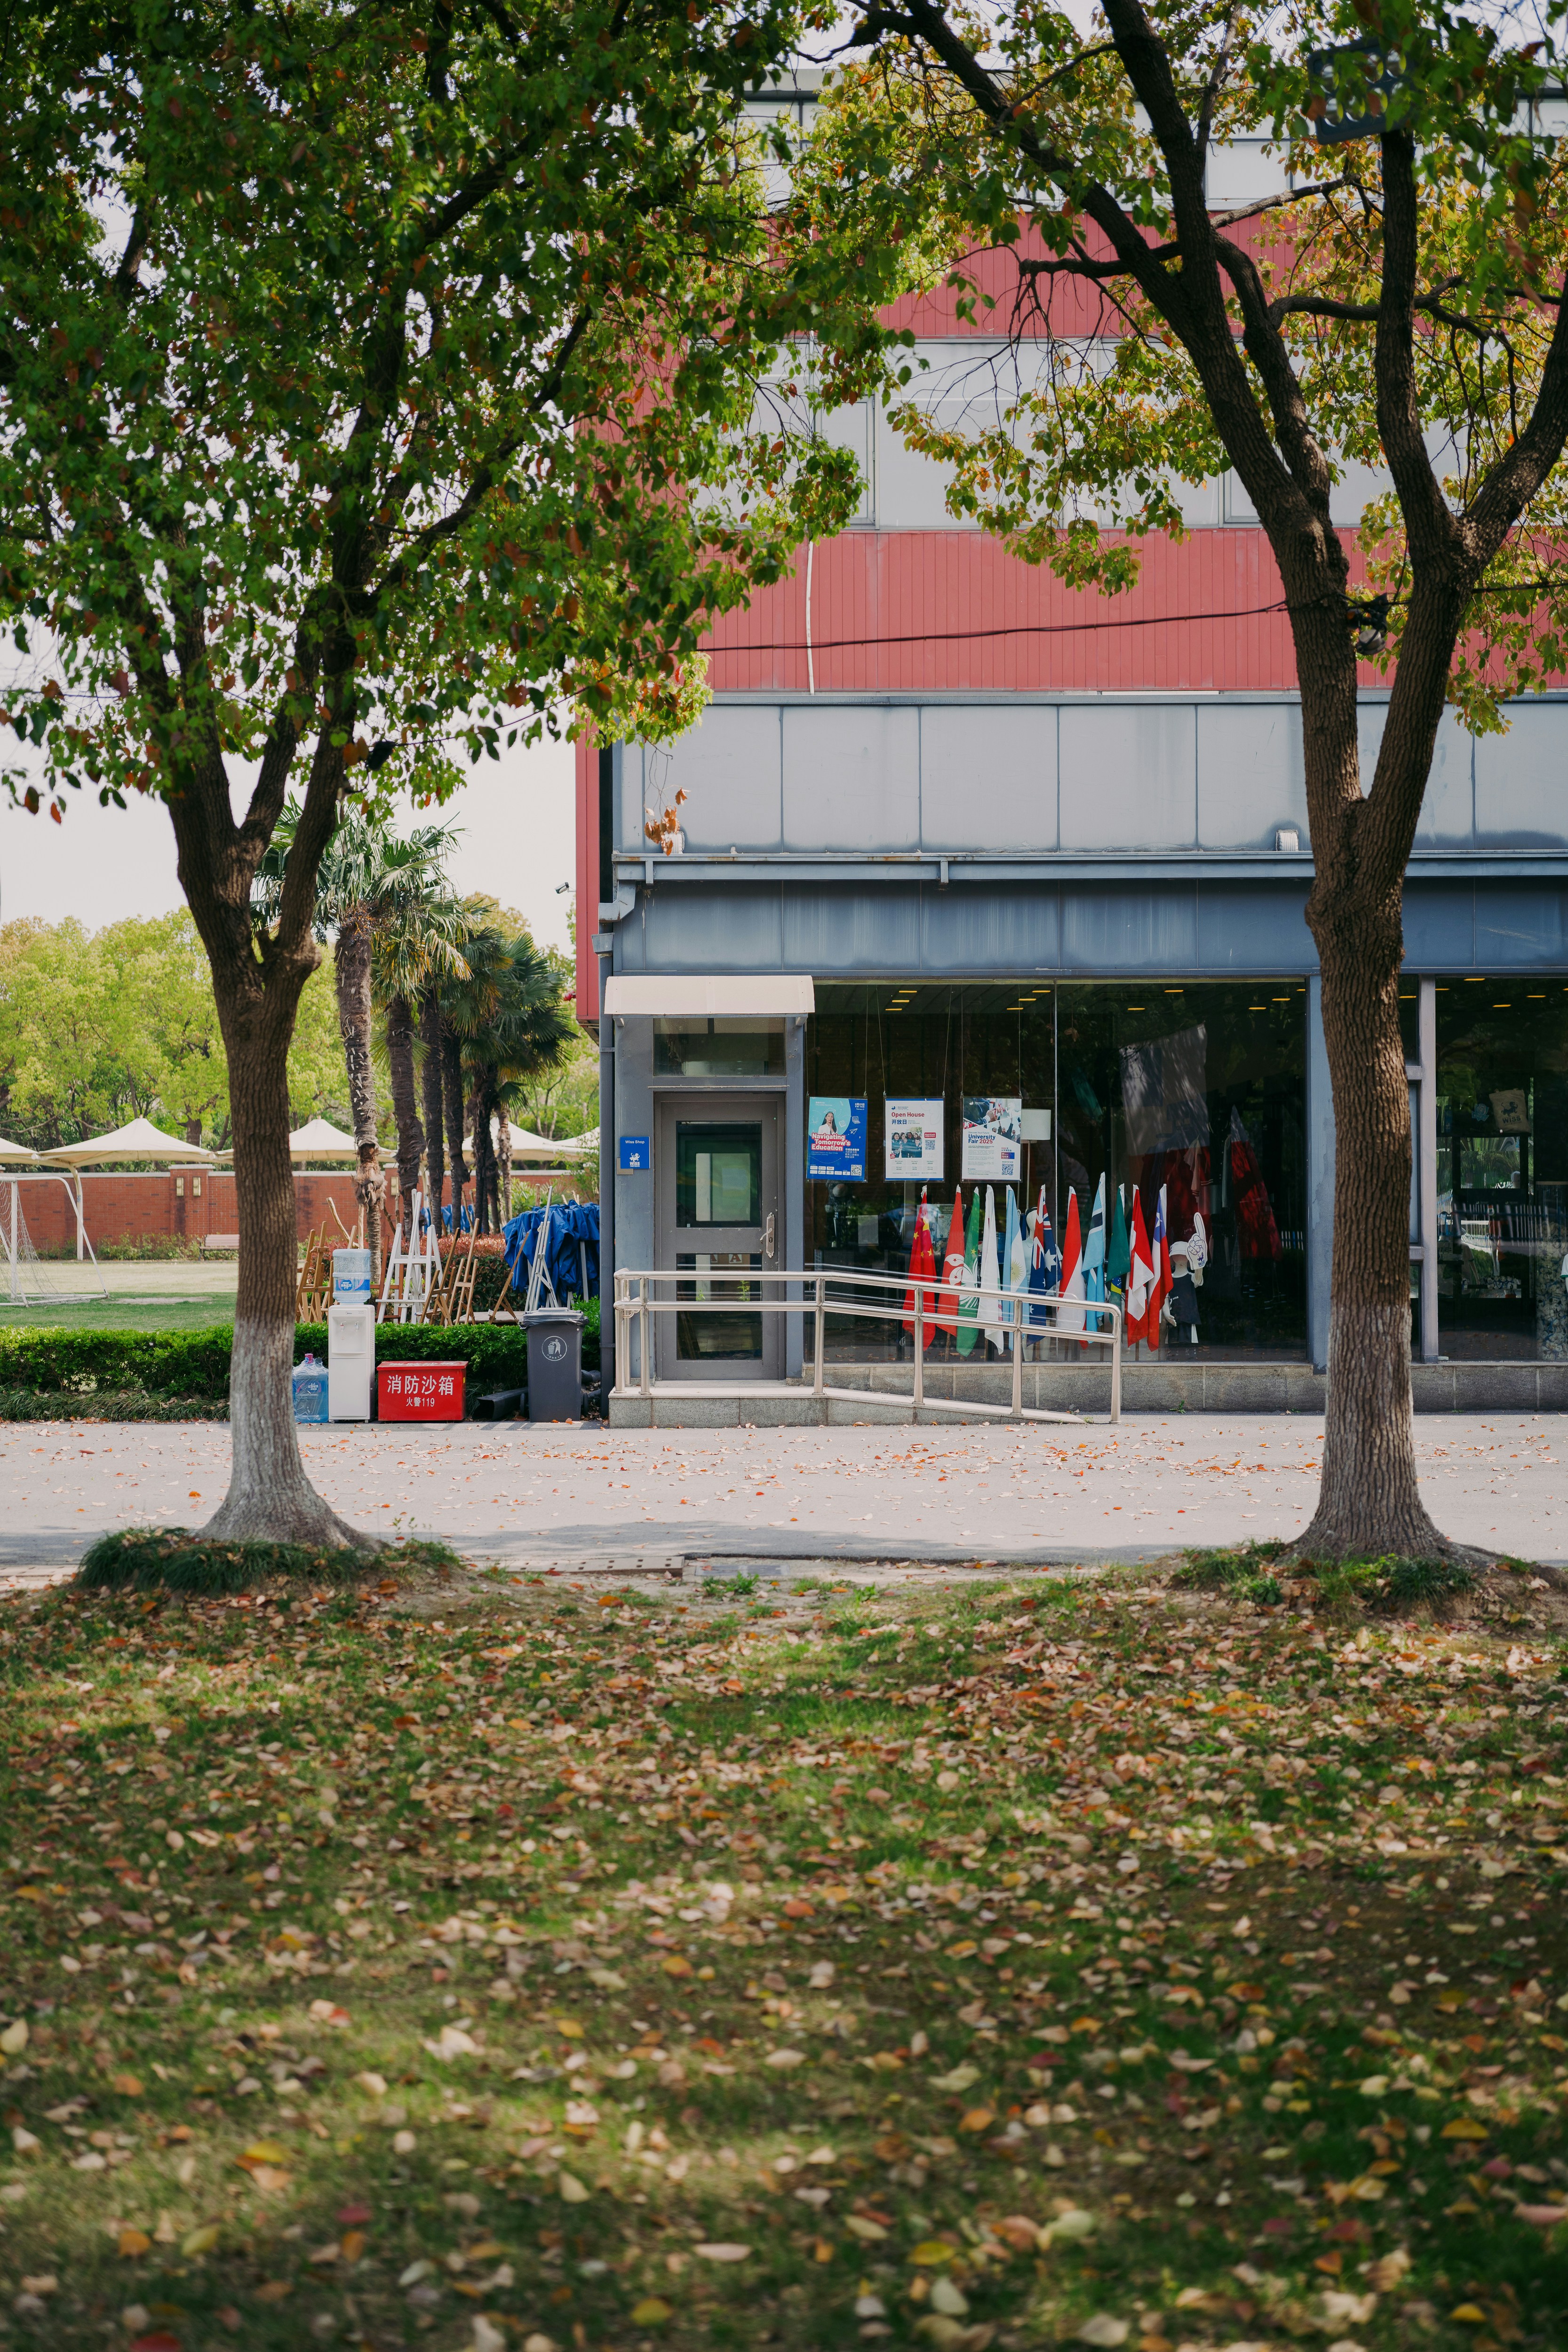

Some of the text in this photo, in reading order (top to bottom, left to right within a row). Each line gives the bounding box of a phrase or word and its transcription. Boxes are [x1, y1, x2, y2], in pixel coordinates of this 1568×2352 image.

[387, 1375, 454, 1395] 消防沙箱
[406, 1397, 435, 1407] 火警119
